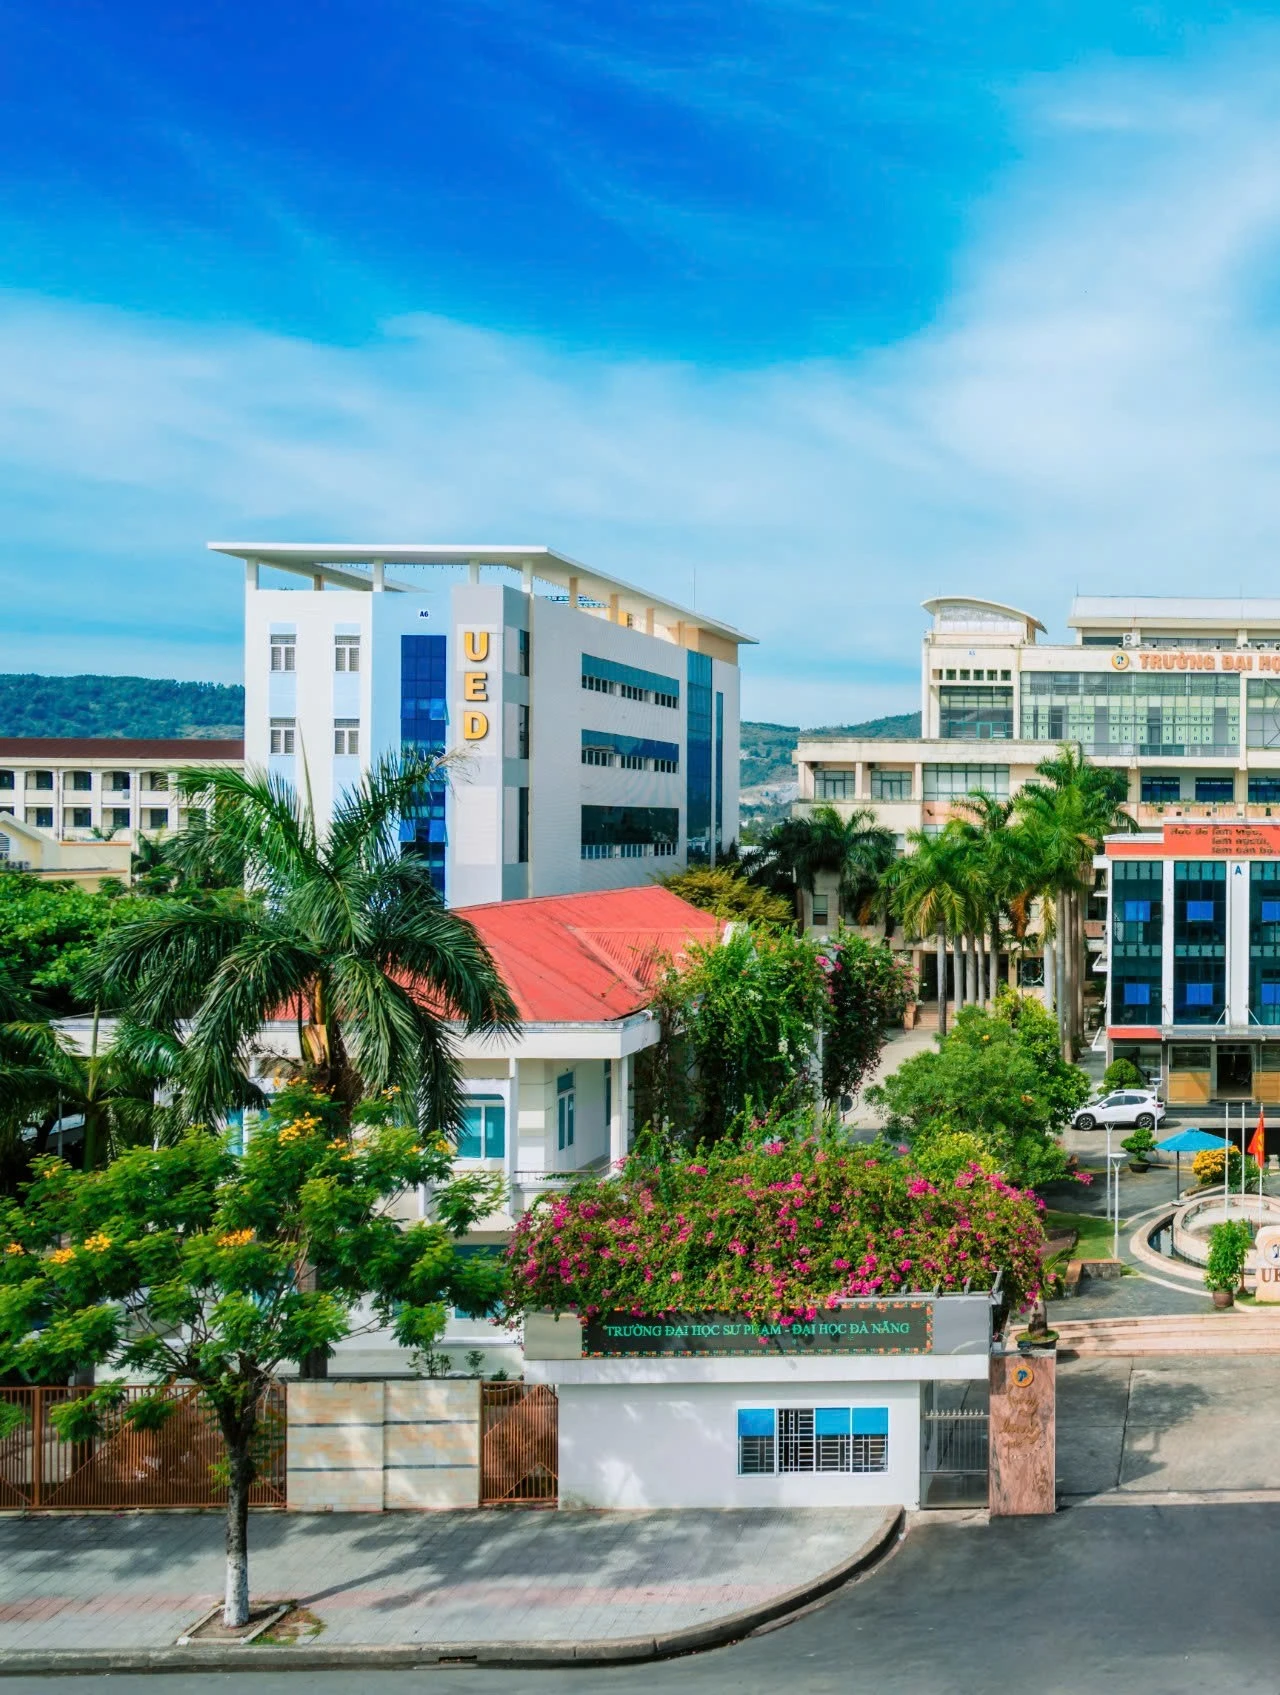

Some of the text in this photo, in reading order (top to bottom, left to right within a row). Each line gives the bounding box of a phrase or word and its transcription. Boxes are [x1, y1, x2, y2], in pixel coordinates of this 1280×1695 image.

[419, 610, 429, 618] A6
[1139, 651, 1215, 670] TRƯỜNG
[464, 632, 490, 741] UED
[1234, 865, 1242, 875] A
[606, 1323, 661, 1337] TRƯỜNG
[665, 1324, 689, 1338] ĐẠI
[691, 1324, 720, 1337] HỌC
[723, 1323, 742, 1336] SƯ
[792, 1323, 816, 1337] ĐẠI
[819, 1323, 847, 1336] HỌC
[850, 1320, 869, 1334] ĐÀ
[871, 1320, 910, 1334] NẴNG
